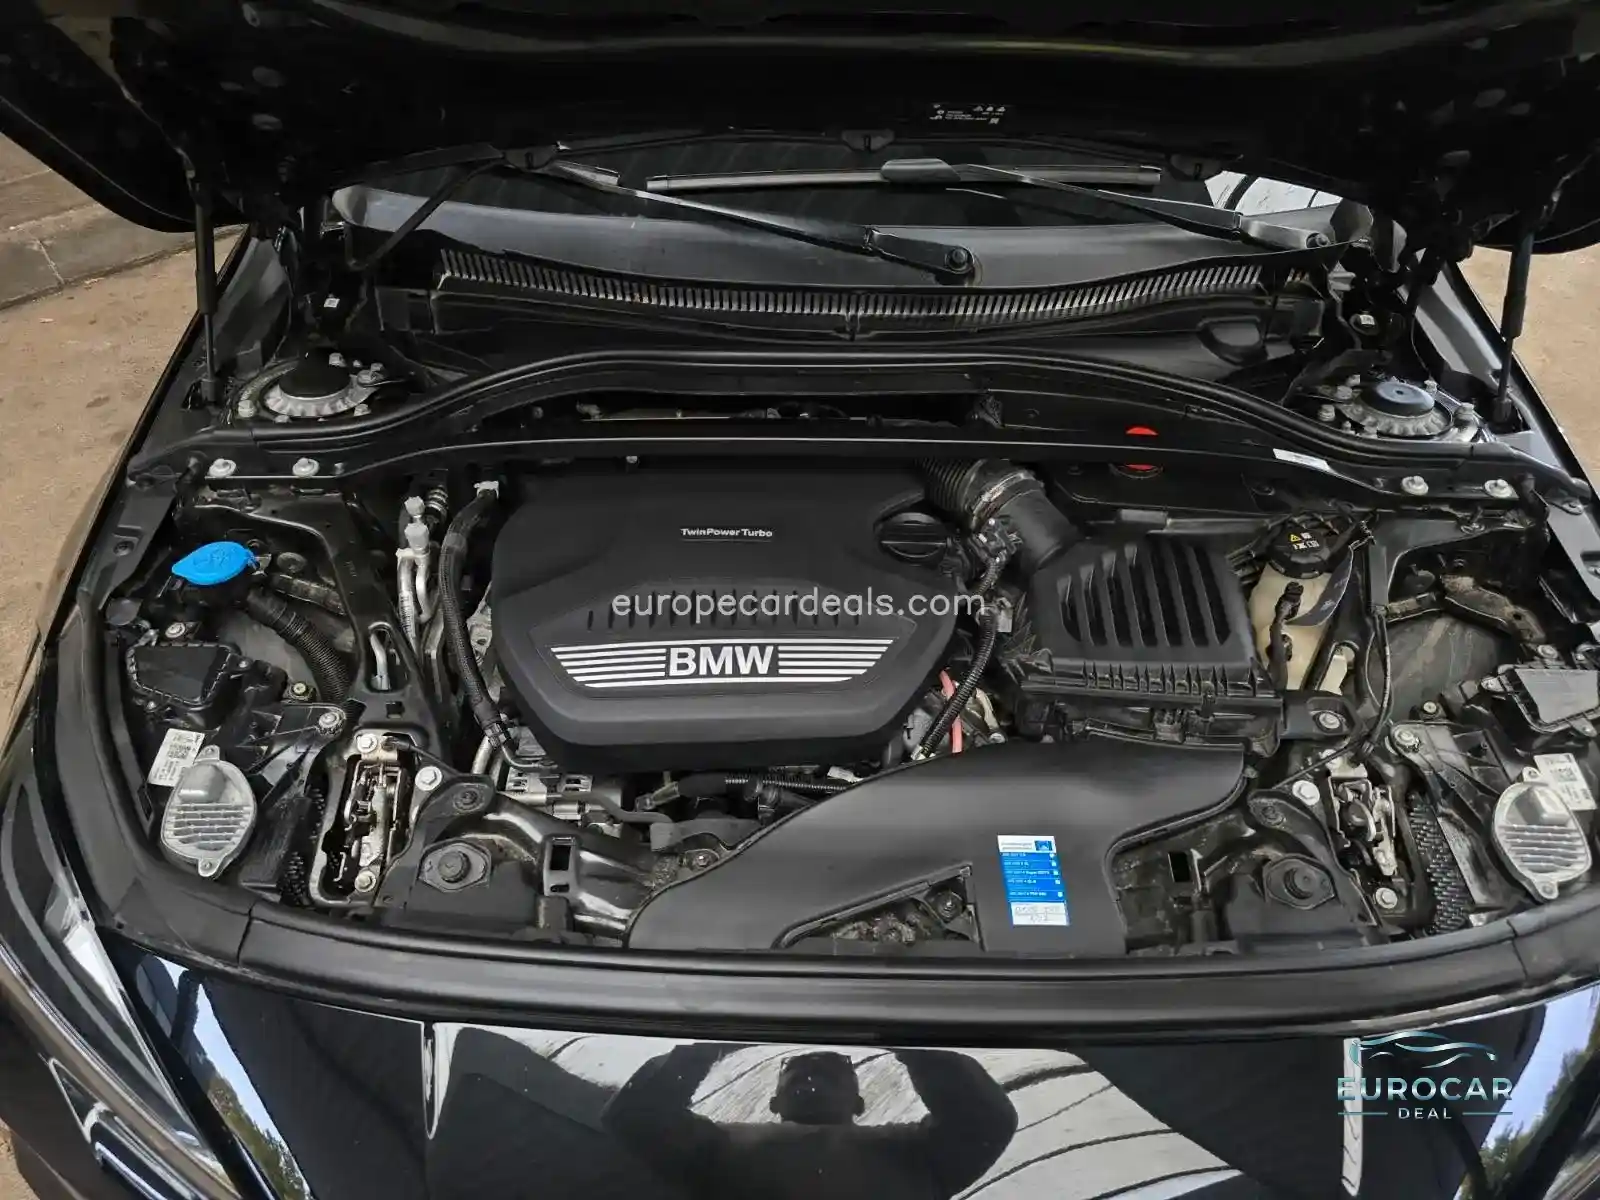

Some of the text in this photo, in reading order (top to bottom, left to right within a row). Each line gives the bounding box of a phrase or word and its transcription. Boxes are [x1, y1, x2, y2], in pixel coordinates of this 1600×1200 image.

[680, 528, 773, 538] TwinPower Turbo
[668, 645, 774, 677] BMW
